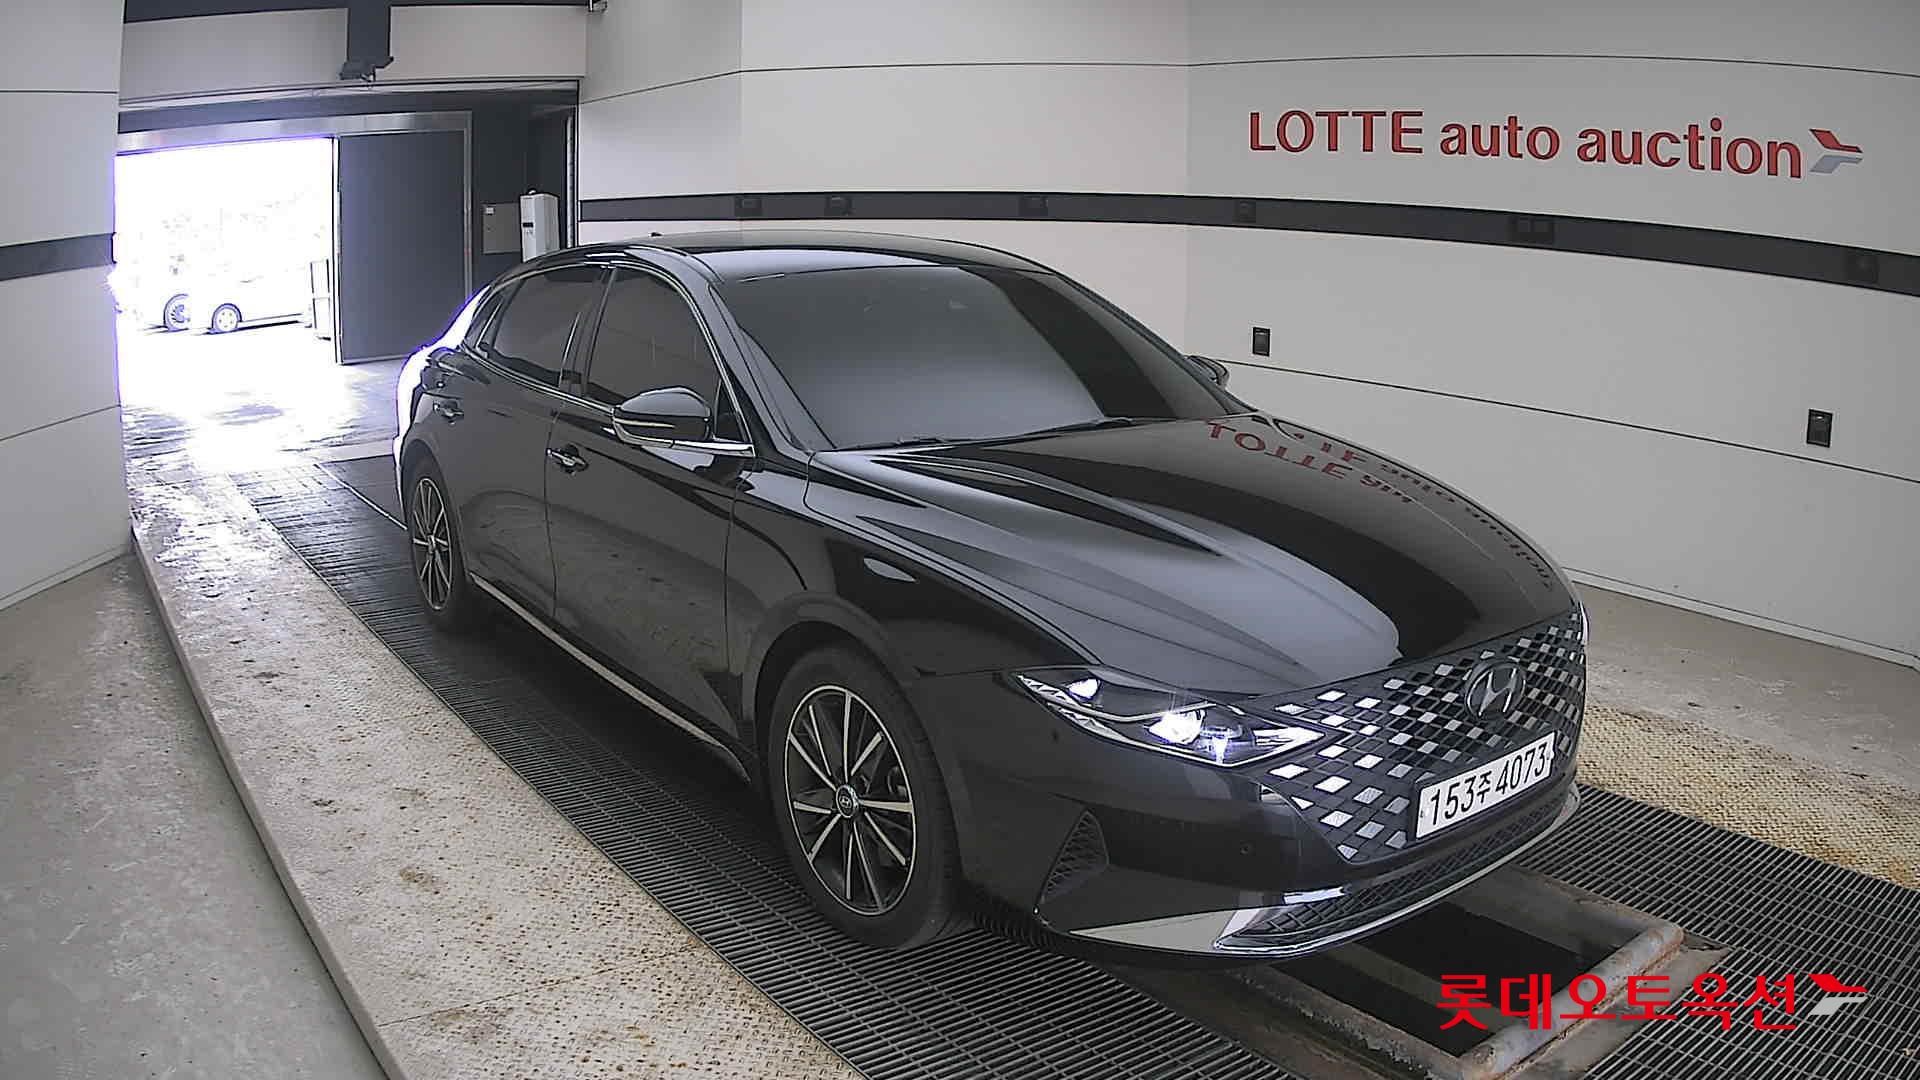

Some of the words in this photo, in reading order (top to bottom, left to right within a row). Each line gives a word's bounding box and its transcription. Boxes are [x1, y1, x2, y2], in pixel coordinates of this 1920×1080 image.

[1249, 110, 1424, 154] LOTTE
[1440, 115, 1560, 160] auto
[1575, 117, 1802, 179] auction
[1430, 770, 1492, 826] 153주
[1495, 741, 1548, 796] 4073
